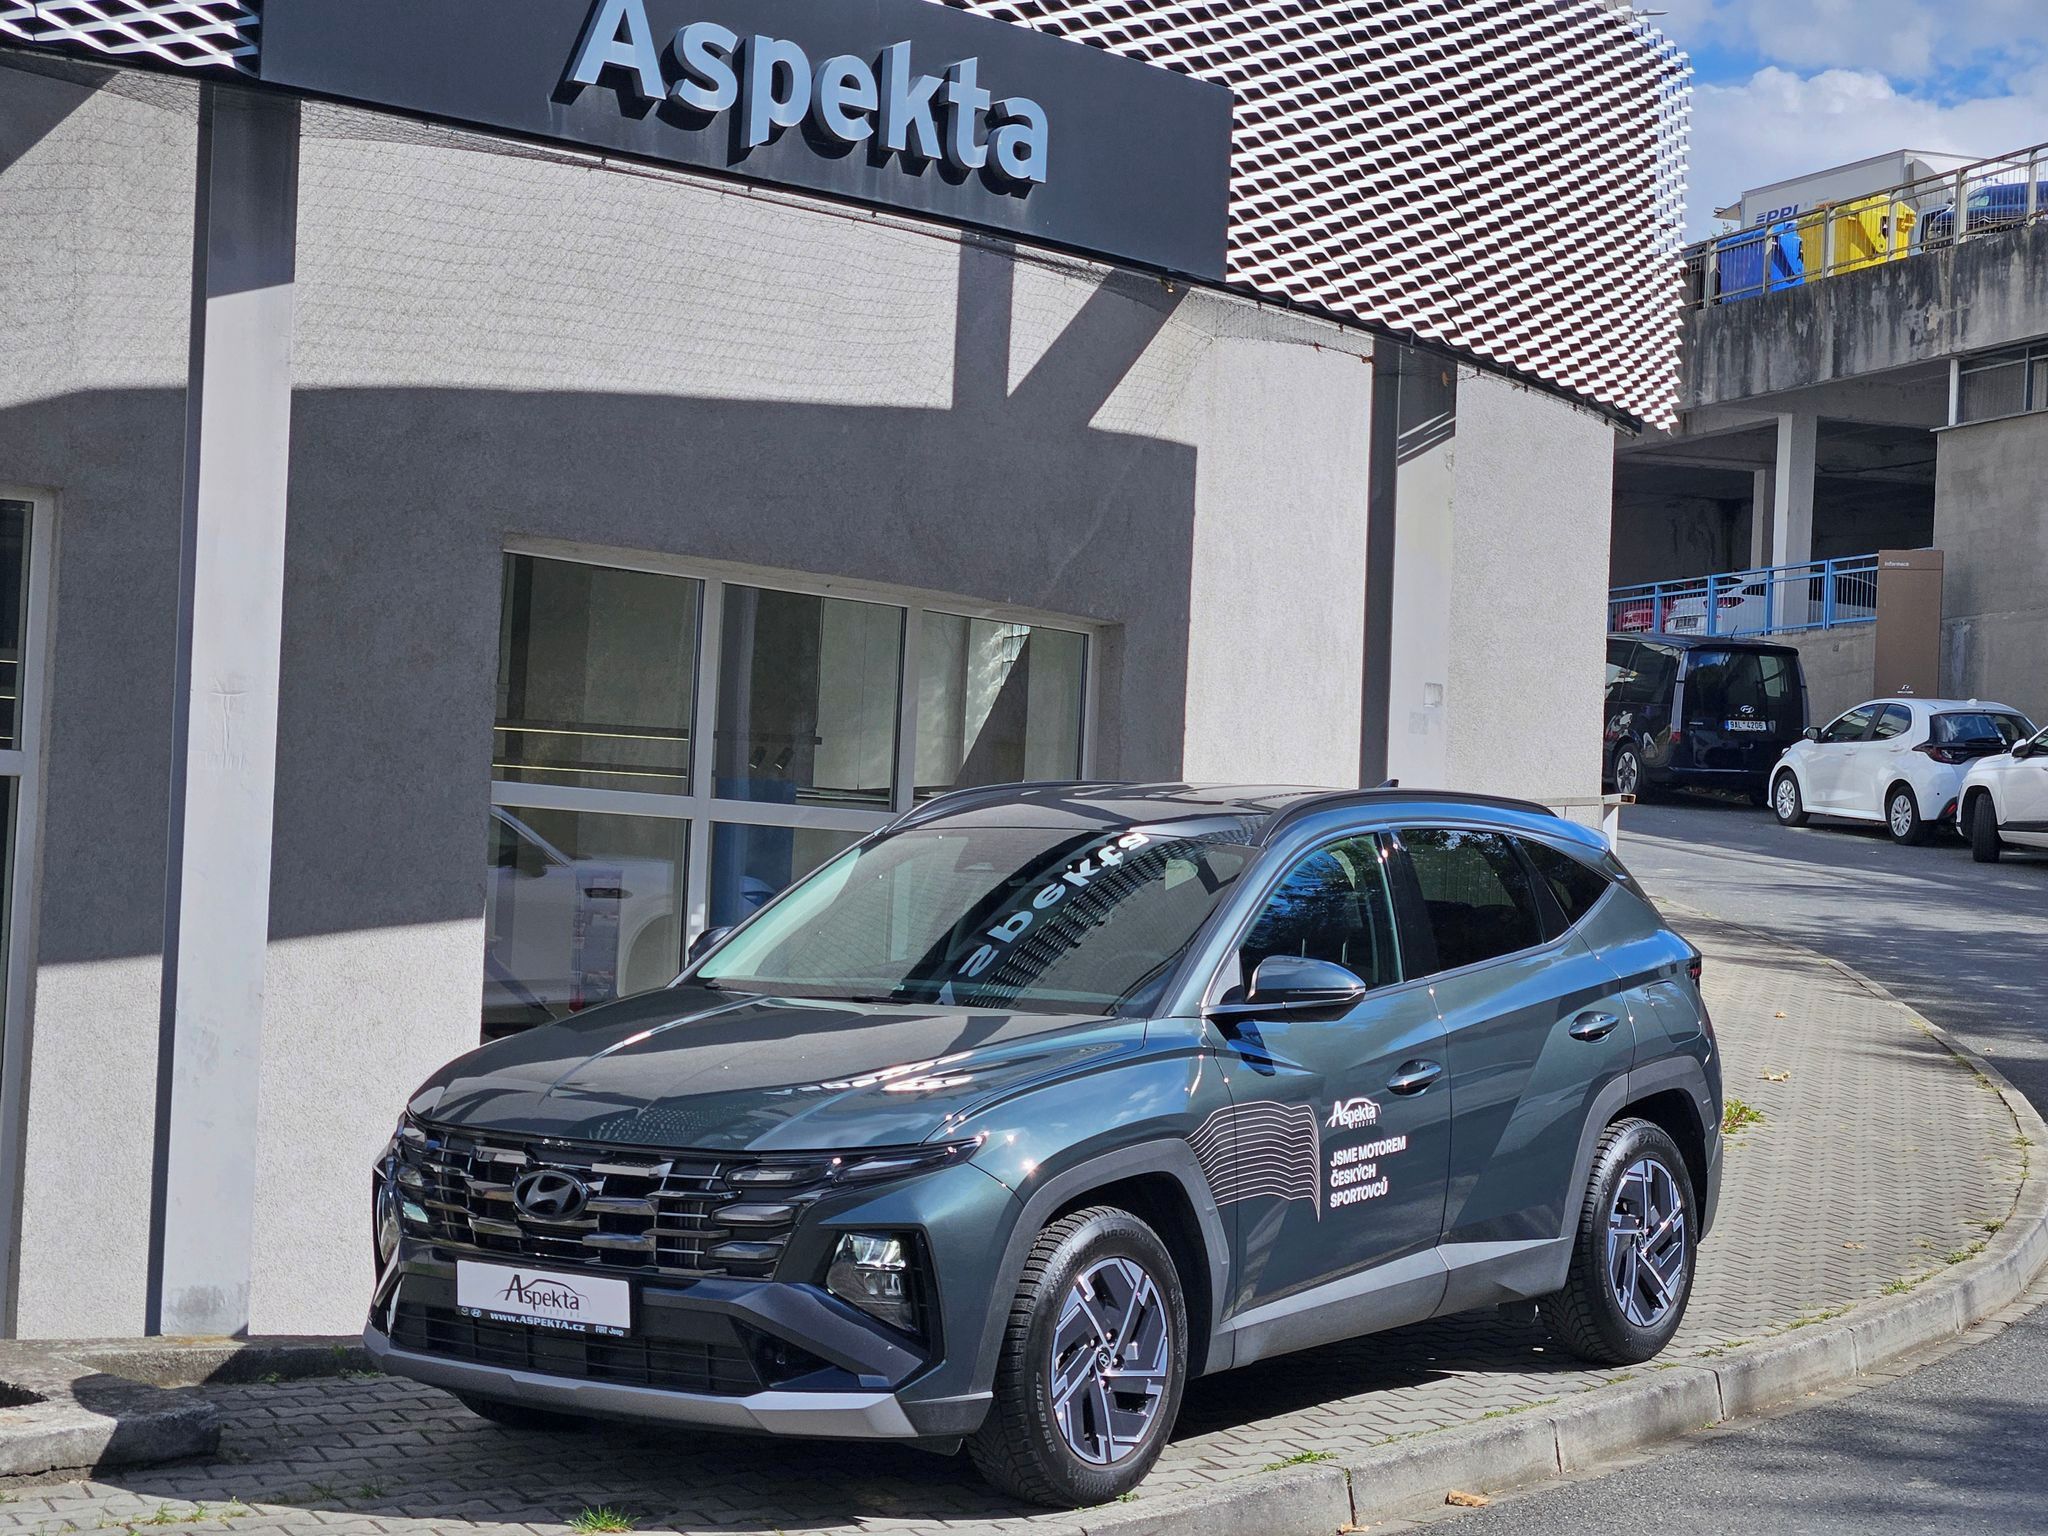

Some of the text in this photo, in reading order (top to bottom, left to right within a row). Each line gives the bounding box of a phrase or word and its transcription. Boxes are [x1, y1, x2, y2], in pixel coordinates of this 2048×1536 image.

[570, 0, 1049, 184] Aspekta
[1330, 1099, 1377, 1129] Aspekta
[1330, 1136, 1407, 1166] JSME MOTOREM
[1330, 1163, 1376, 1188] ČESKÝCH
[1330, 1176, 1389, 1208] SPORTOVCŮ
[504, 1274, 580, 1312] Aspekta
